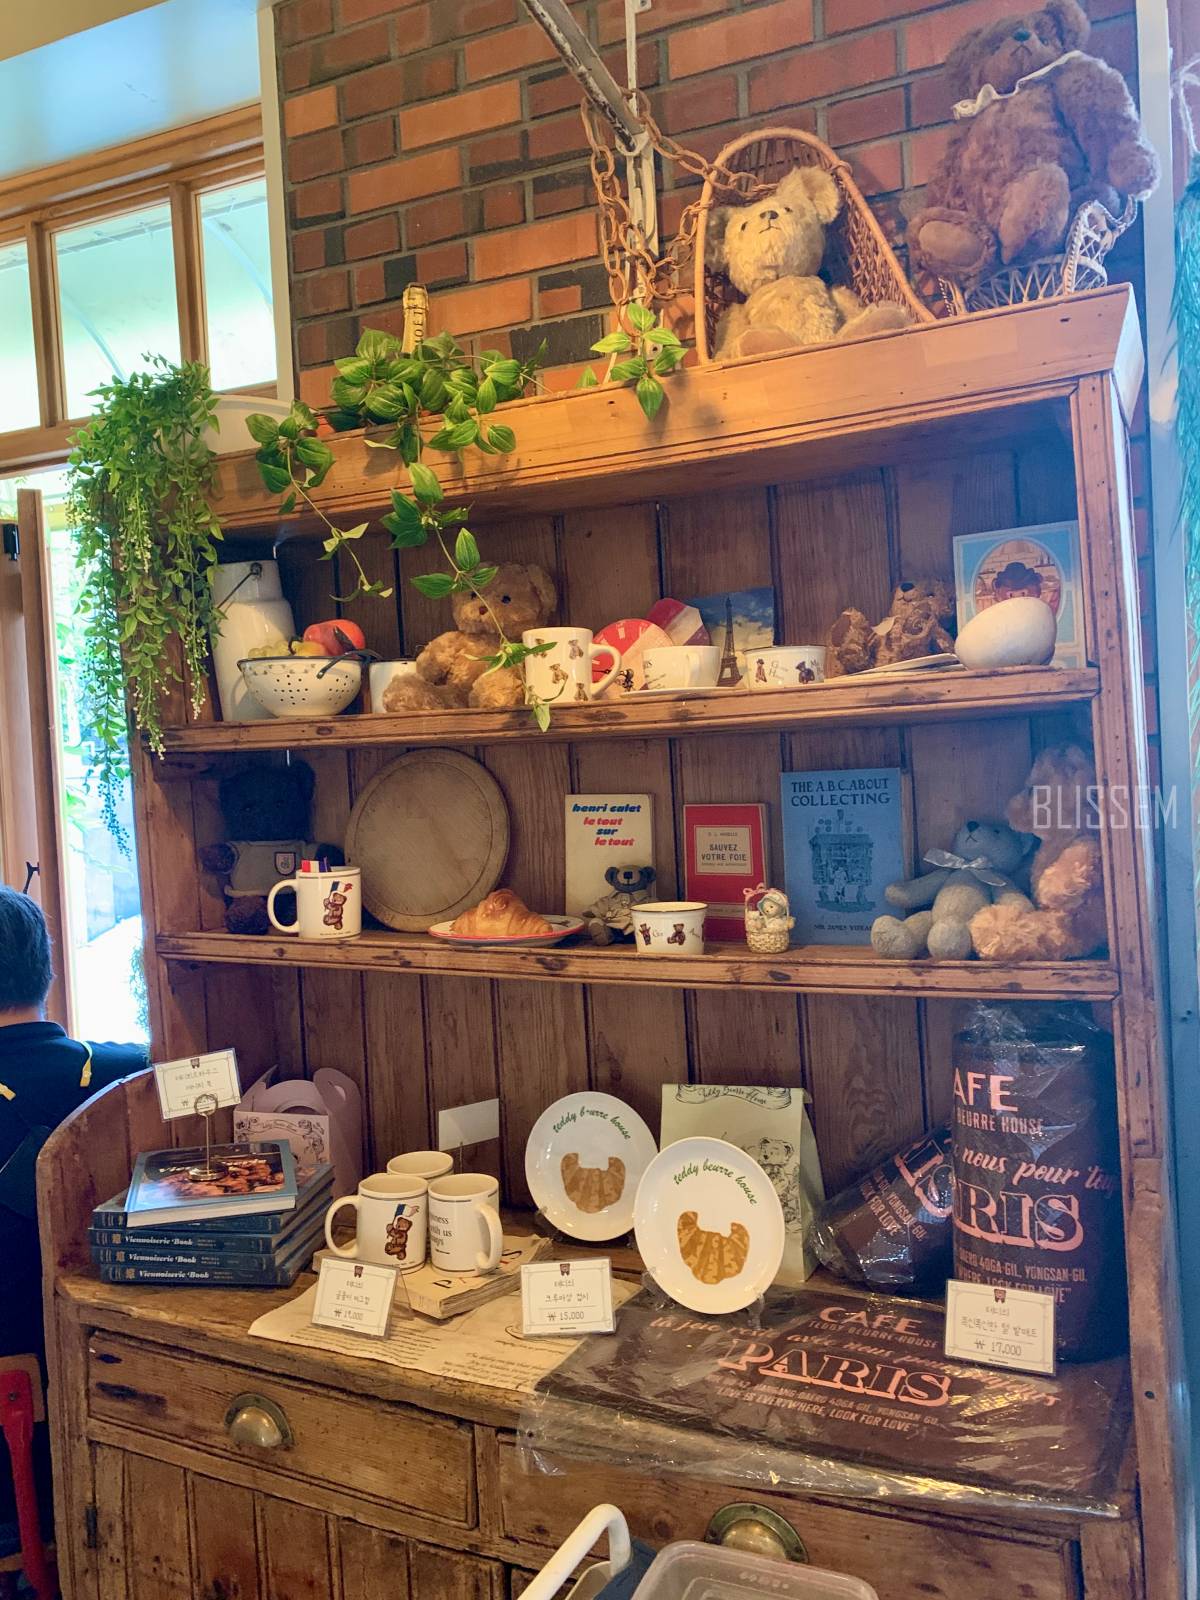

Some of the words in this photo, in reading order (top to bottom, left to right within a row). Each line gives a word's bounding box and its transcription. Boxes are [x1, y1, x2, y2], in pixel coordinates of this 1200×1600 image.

[791, 781, 814, 793] THE
[791, 793, 891, 807] COLLECTING
[572, 803, 608, 812] henri
[610, 803, 641, 812] calet
[583, 817, 595, 825] le
[597, 817, 623, 825] tout
[594, 837, 607, 846] le
[608, 838, 634, 846] tout
[553, 1112, 577, 1133] teddy
[610, 1115, 631, 1140] house
[1001, 1116, 1044, 1135] HOUSE
[962, 1147, 1008, 1174] nous
[1012, 1161, 1080, 1186] pour
[673, 1162, 699, 1185] teddy
[703, 1158, 734, 1178] beurre
[735, 1175, 757, 1205] house
[868, 1196, 886, 1217] FOR
[125, 1235, 171, 1246] Viennoiserie
[172, 1237, 193, 1246] Book
[128, 1253, 174, 1263] Viennoiserie
[175, 1255, 197, 1264] Book
[139, 1270, 186, 1279] Viennoiserie
[187, 1270, 209, 1279] Book
[560, 1311, 585, 1320] 15,000
[819, 1306, 922, 1336] CAFE
[809, 1320, 846, 1333] TEDDY
[843, 1340, 894, 1358] nous
[992, 1342, 1021, 1356] 17,000
[717, 1338, 951, 1408] PARIS
[829, 1408, 858, 1423] LOOK
[859, 1413, 882, 1426] FOR
